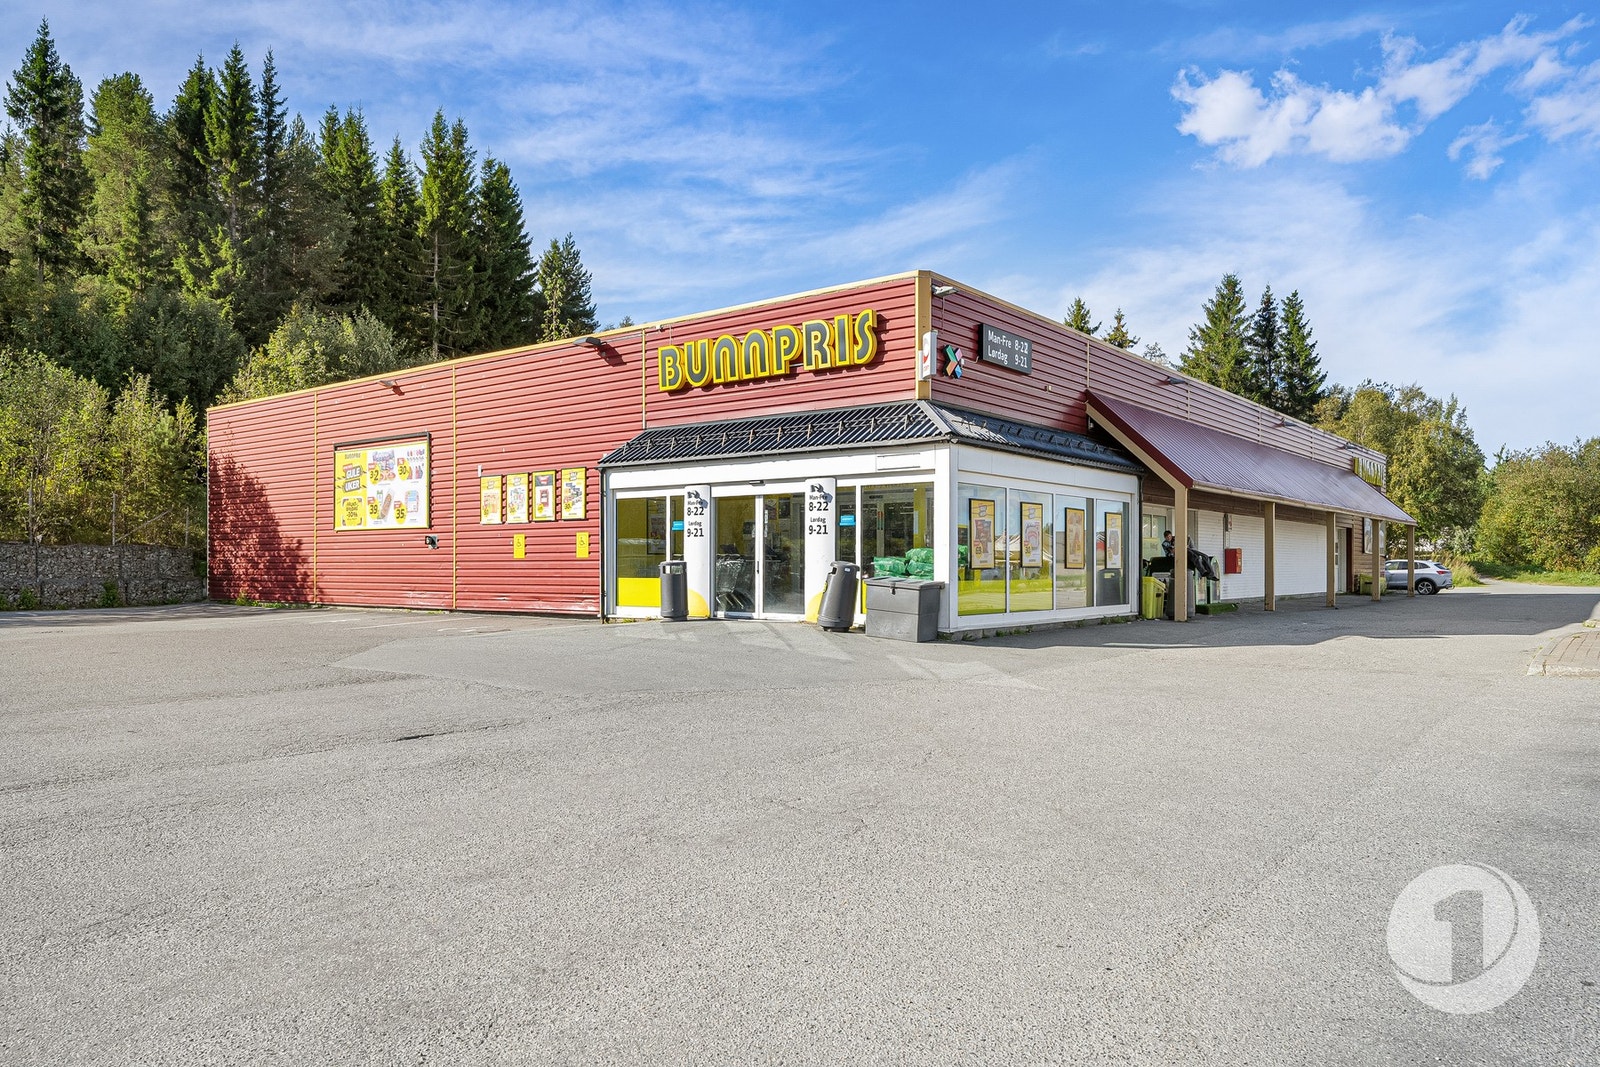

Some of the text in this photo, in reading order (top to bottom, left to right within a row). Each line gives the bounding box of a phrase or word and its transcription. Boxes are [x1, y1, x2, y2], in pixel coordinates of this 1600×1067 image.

[987, 330, 1028, 354] Man-Fre 8-22
[658, 308, 877, 391] BUNNPRIS
[987, 345, 1028, 369] Lørdag 9-21
[687, 507, 704, 516] 8-22
[808, 501, 829, 512] 8-22
[687, 528, 704, 537] 9-21
[808, 525, 829, 535] 9-21
